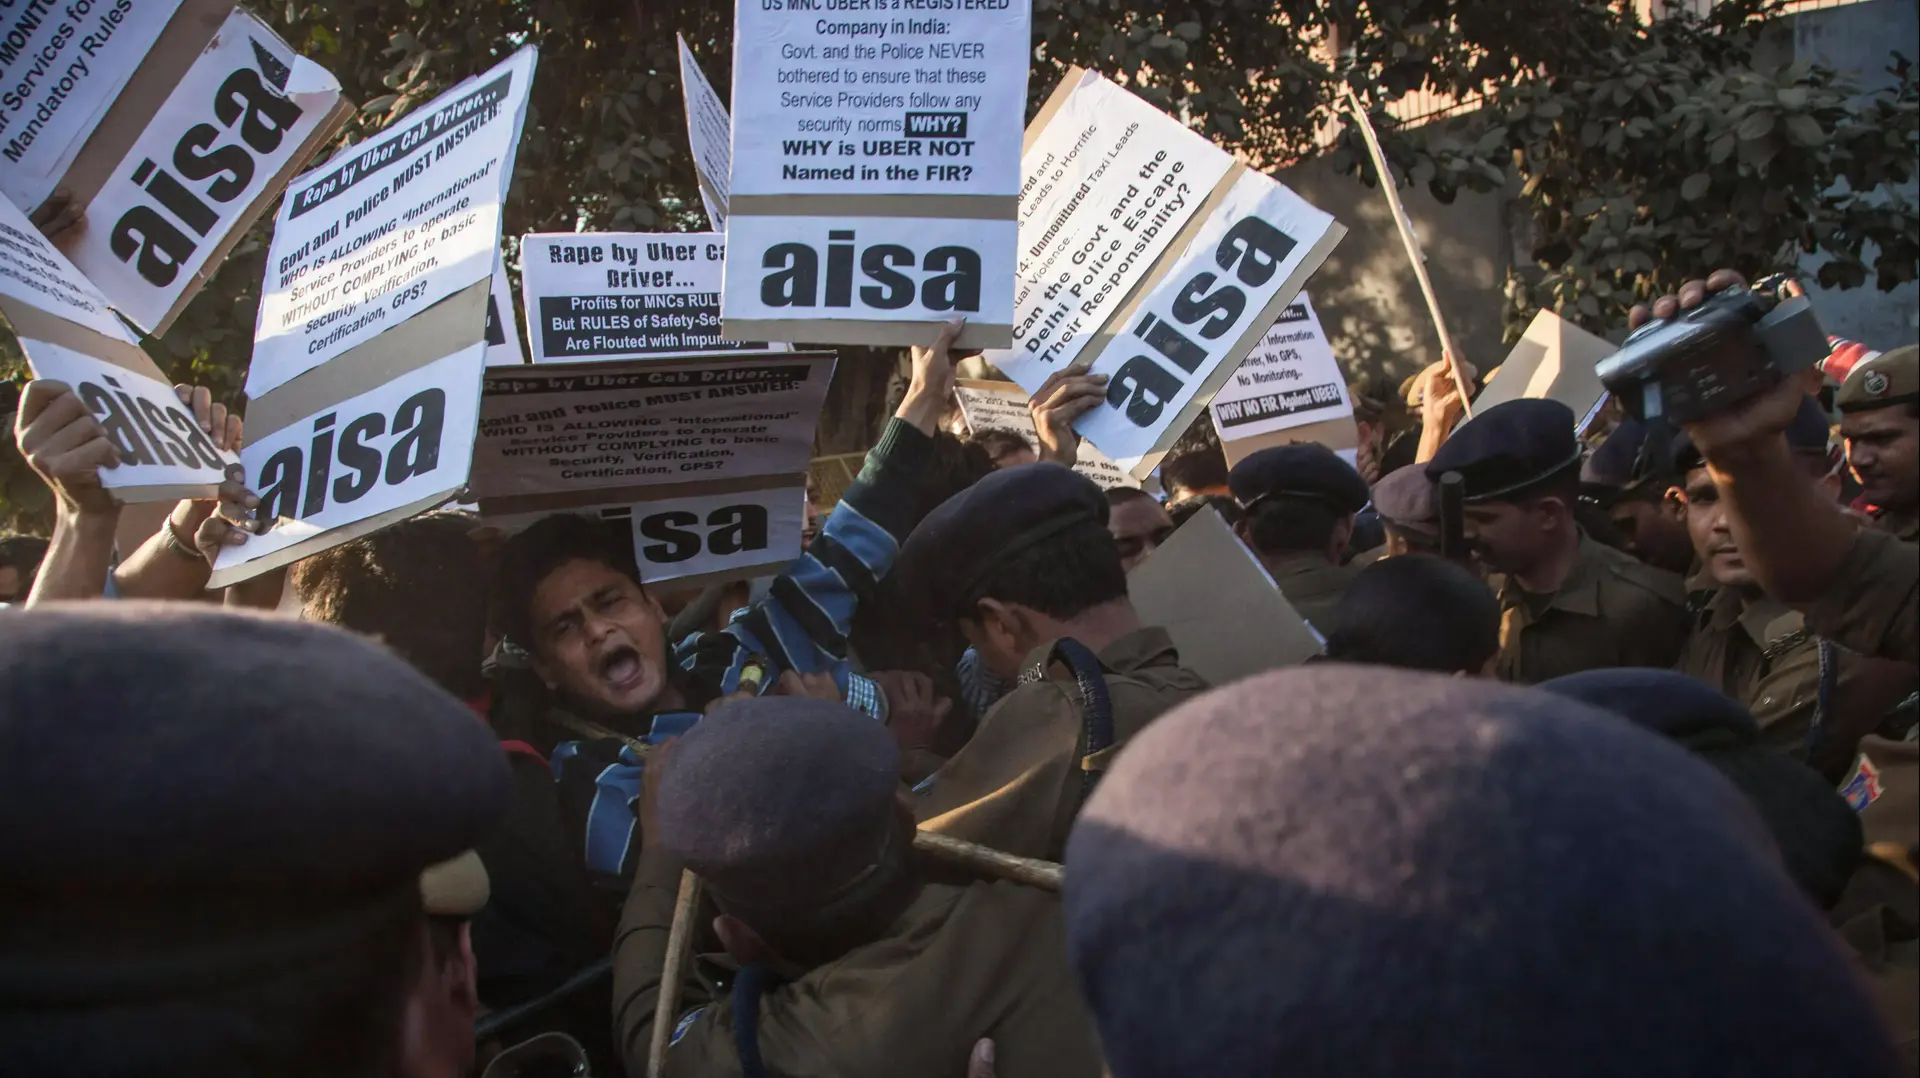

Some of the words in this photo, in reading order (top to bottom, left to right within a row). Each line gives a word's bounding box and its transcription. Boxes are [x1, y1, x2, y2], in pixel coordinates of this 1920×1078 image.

[816, 19, 888, 38] Company
[891, 18, 905, 35] in
[908, 18, 950, 35] India:
[781, 43, 817, 60] Govt.
[823, 43, 849, 60] and
[854, 43, 876, 60] the
[881, 43, 924, 60] Police
[929, 43, 985, 59] NEVER
[3, 22, 75, 111] Services
[778, 68, 839, 84] bothered
[844, 69, 858, 84] to
[862, 71, 911, 84] ensure
[915, 68, 942, 84] that
[946, 68, 986, 84] these
[3, 56, 89, 163] Mandatory
[80, 0, 132, 57] Rules
[780, 92, 833, 108] Service
[838, 92, 905, 108] Providers
[909, 92, 951, 108] follow
[955, 95, 982, 112] any
[798, 115, 852, 136] security
[910, 115, 962, 133] WHY?
[782, 140, 832, 156] WHY
[838, 140, 856, 156] is
[862, 140, 922, 156] UBER
[928, 141, 975, 156] NOT
[110, 67, 304, 288] aisa
[302, 178, 337, 207] Rape
[340, 163, 357, 187] by
[361, 142, 396, 171] Uber
[401, 121, 429, 151] Cab
[782, 164, 855, 181] Named
[861, 164, 879, 180] in
[885, 164, 919, 181] the
[926, 165, 974, 181] FIR?
[1023, 182, 1053, 218] Leads
[1051, 170, 1063, 183] to
[1061, 124, 1097, 168] Horrific
[1036, 153, 1055, 178] and
[1030, 183, 1091, 258] Unmonitored
[1088, 159, 1110, 184] Taxi
[1108, 120, 1140, 158] Leads
[279, 241, 311, 274] Govt
[312, 220, 340, 252] and
[345, 186, 390, 229] Police
[393, 150, 432, 194] MUST
[280, 264, 308, 289] WHO
[312, 255, 326, 272] IS
[329, 218, 397, 264] ALLOWING
[290, 270, 336, 303] Service
[340, 238, 398, 277] Providers
[403, 227, 416, 243] to
[420, 197, 470, 233] operate
[549, 244, 604, 265] Rape
[611, 242, 638, 266] by
[646, 242, 697, 262] Uber
[1012, 305, 1044, 341] Can
[1044, 271, 1072, 301] the
[1071, 223, 1109, 266] Govt
[1110, 184, 1140, 221] and
[1139, 149, 1168, 180] the
[1025, 302, 1070, 354] Delhi
[1070, 238, 1122, 299] Police
[1123, 160, 1185, 232] Escape
[281, 285, 338, 328] WITHOUT
[342, 244, 419, 295] COMPLYING
[423, 236, 436, 251] to
[441, 213, 477, 242] basic
[760, 229, 981, 312] aisa
[1040, 317, 1083, 364] Their
[1080, 182, 1191, 317] Responsibility?
[305, 301, 357, 335] Security,
[364, 256, 438, 305] Verification,
[571, 297, 618, 311] Profits
[621, 296, 641, 309] for
[644, 295, 684, 309] MNCs
[308, 306, 387, 355] Certification,
[392, 280, 428, 310] GPS?
[552, 317, 576, 331] But
[580, 315, 630, 331] RULES
[633, 315, 648, 329] of
[1106, 215, 1298, 428] aisa
[565, 336, 590, 351] Are
[593, 334, 647, 349] Flouted
[649, 333, 678, 348] with
[1266, 329, 1315, 346] Information
[1264, 352, 1278, 365] No
[483, 379, 539, 392] Rape
[584, 375, 639, 386] Uber
[647, 371, 690, 384] Cab
[1237, 375, 1251, 387] No
[525, 407, 567, 422] and
[573, 399, 642, 415] Police
[645, 391, 702, 407] MUST
[1217, 403, 1244, 422] WHY
[1244, 400, 1261, 417] NO
[1262, 397, 1280, 413] FIR
[1280, 390, 1313, 412] Against
[1311, 384, 1341, 403] UBER
[482, 426, 528, 438] WHO
[536, 424, 555, 433] IS
[563, 418, 662, 431] ALLOWING
[510, 434, 578, 446] Service
[586, 430, 669, 440] Providers
[676, 427, 694, 436] to
[700, 425, 768, 436] operate
[501, 443, 589, 457] WITHOUT
[597, 437, 703, 451] COMPLYING
[710, 437, 727, 445] to
[733, 435, 779, 444] basic
[255, 388, 446, 536] aisa
[680, 460, 725, 472] GPS?
[1100, 462, 1120, 472] the
[602, 504, 768, 564] isa
